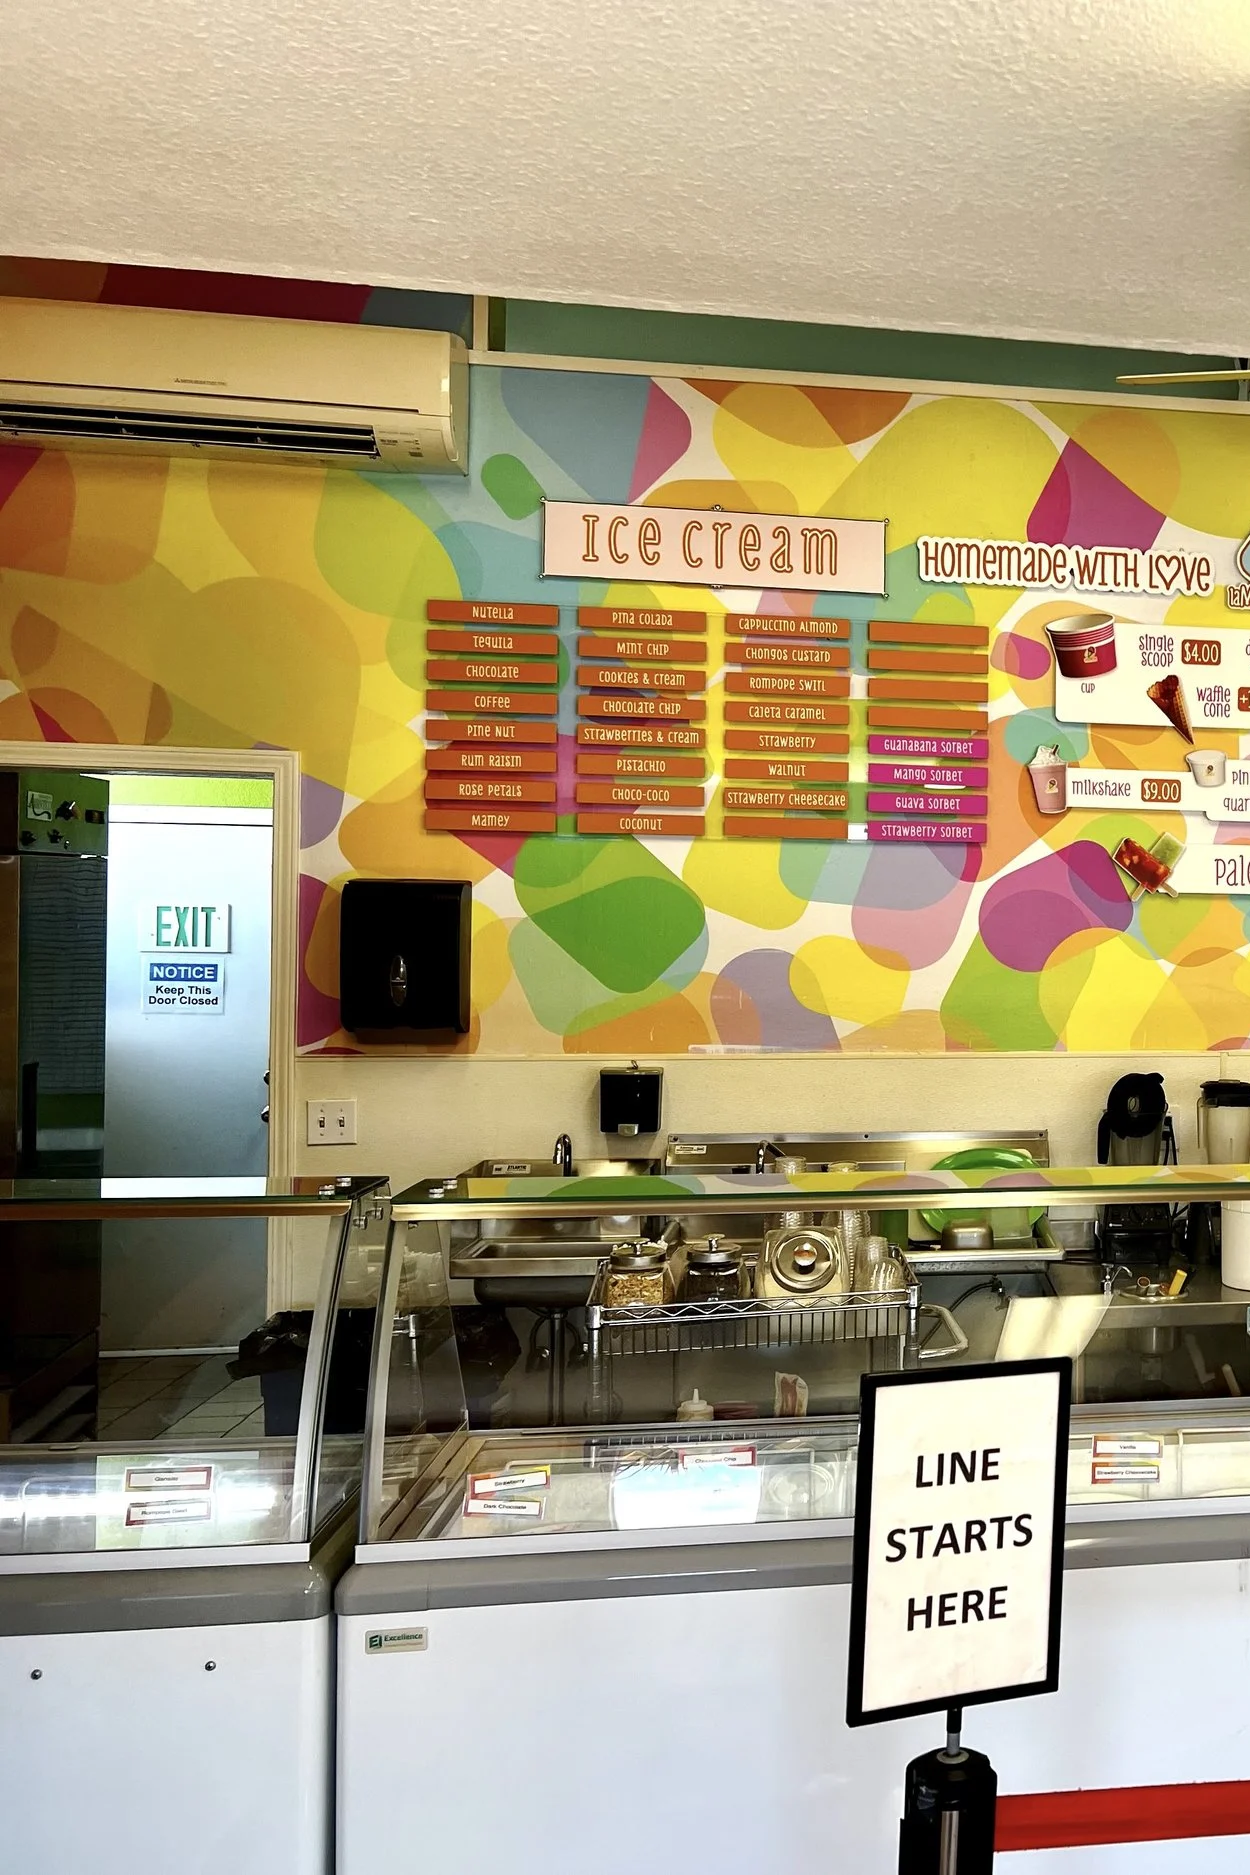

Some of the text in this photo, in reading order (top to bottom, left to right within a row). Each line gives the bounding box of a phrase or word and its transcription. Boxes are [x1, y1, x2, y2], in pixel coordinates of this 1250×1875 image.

[1184, 642, 1219, 663] $4.00
[643, 673, 649, 685] &
[657, 731, 663, 742] &
[1143, 781, 1179, 800] $9.00
[156, 906, 216, 947] EXIT
[153, 966, 214, 979] NOTICE
[156, 985, 211, 995] Keep This
[148, 996, 218, 1005] Door Closed
[916, 1448, 1000, 1487] LINE
[885, 1514, 1033, 1563] STARTS
[907, 1586, 1007, 1631] HERE
